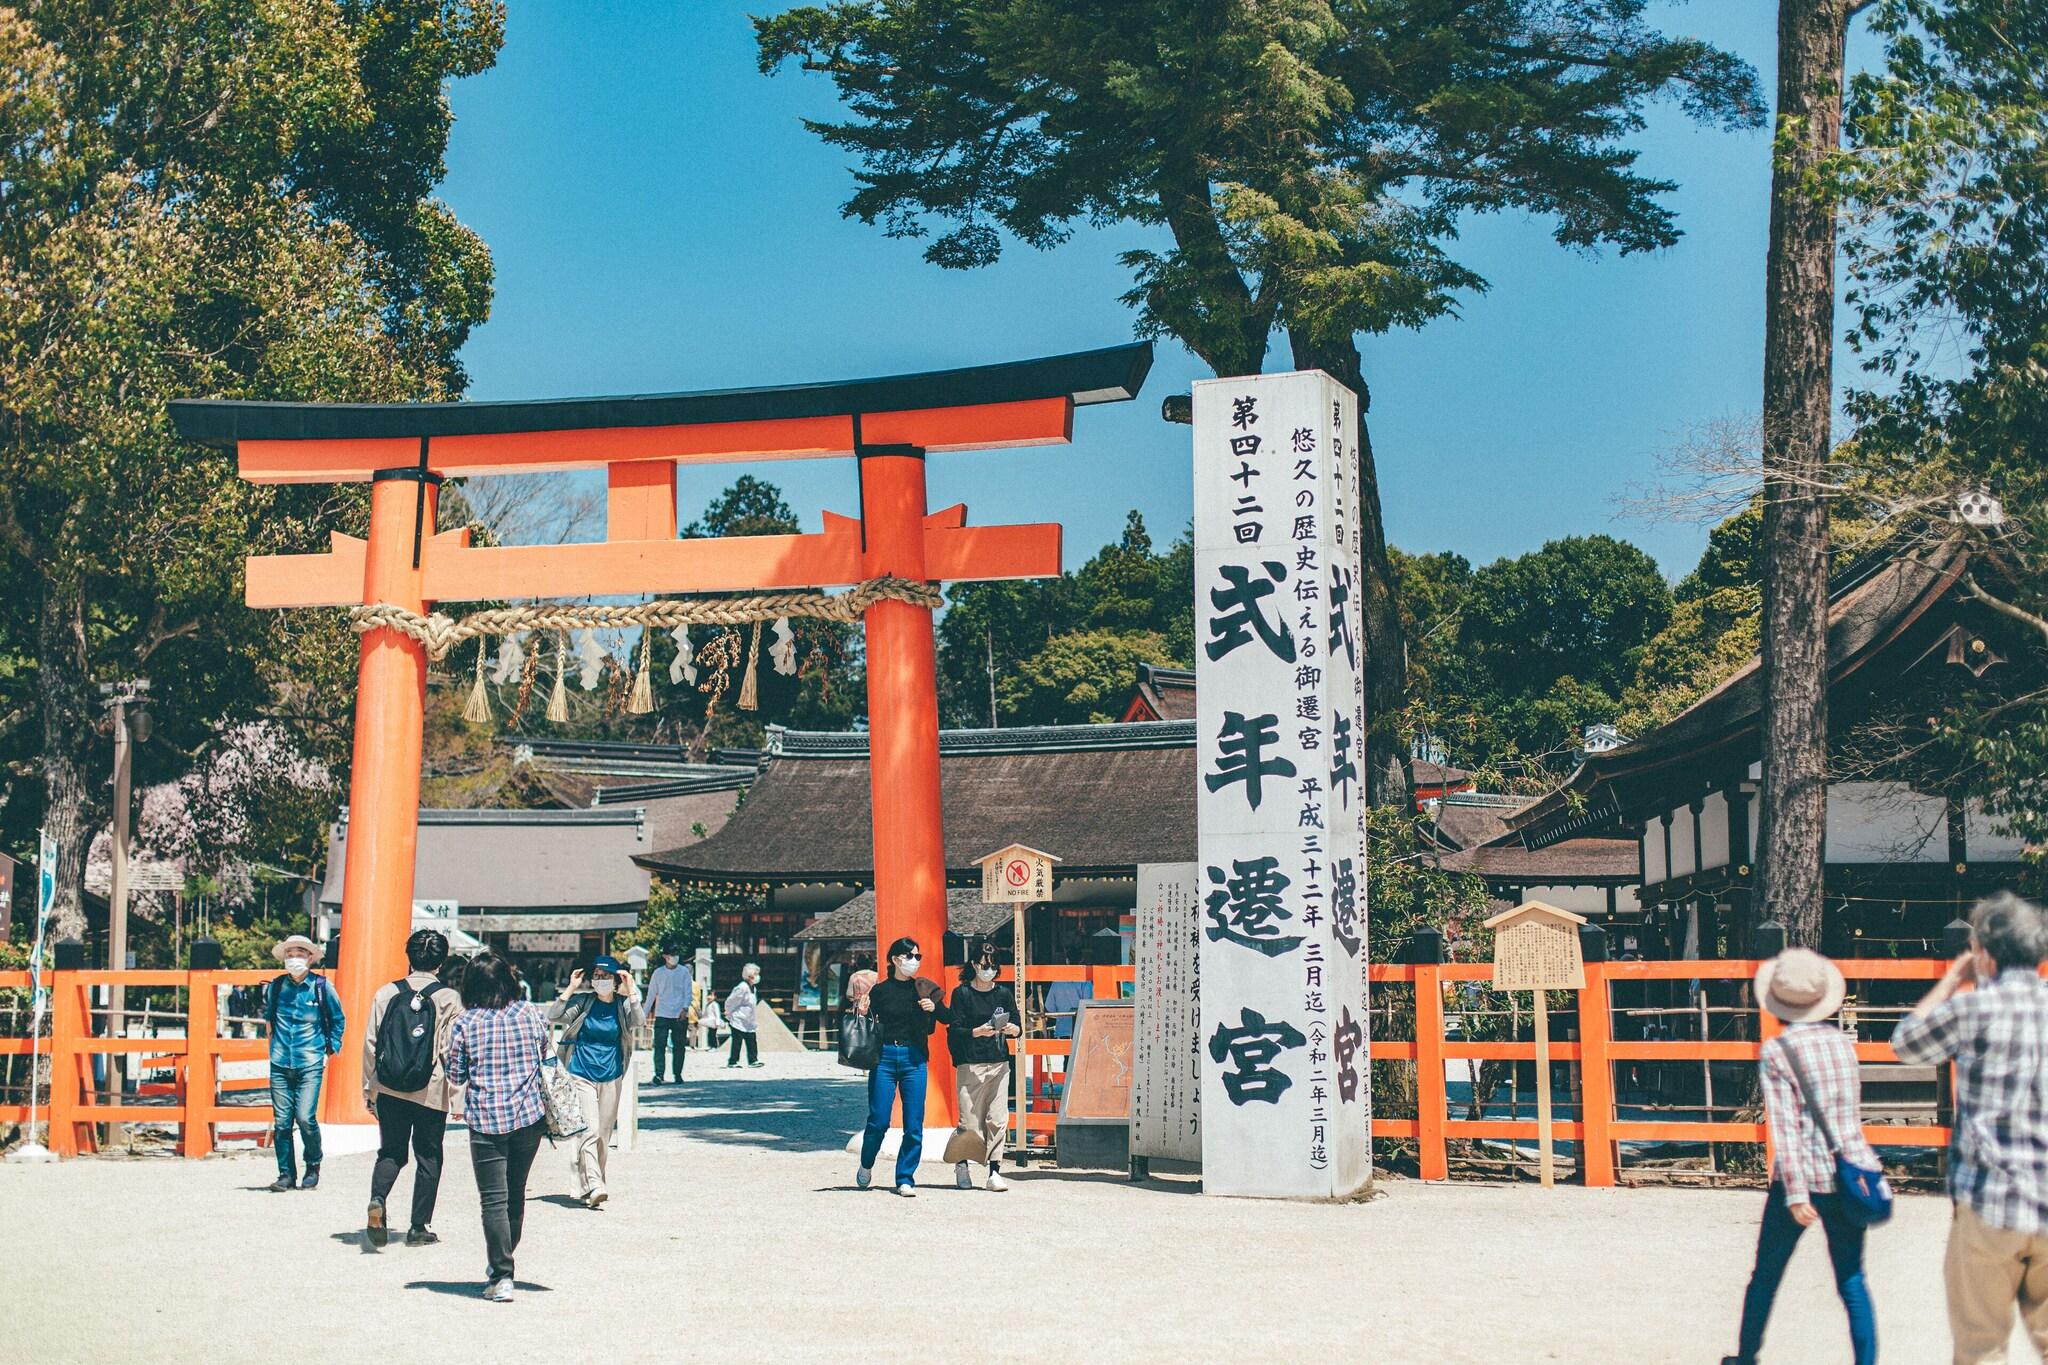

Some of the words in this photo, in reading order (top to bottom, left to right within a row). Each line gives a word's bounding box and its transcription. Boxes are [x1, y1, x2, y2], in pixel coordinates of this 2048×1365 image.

[1230, 395, 1264, 545] 第四十二回
[1333, 399, 1345, 545] 第四十二回
[1035, 857, 1044, 898] 火気厳禁
[1204, 561, 1307, 1107] 式年遷宮
[1328, 563, 1363, 1105] 式年遷宮
